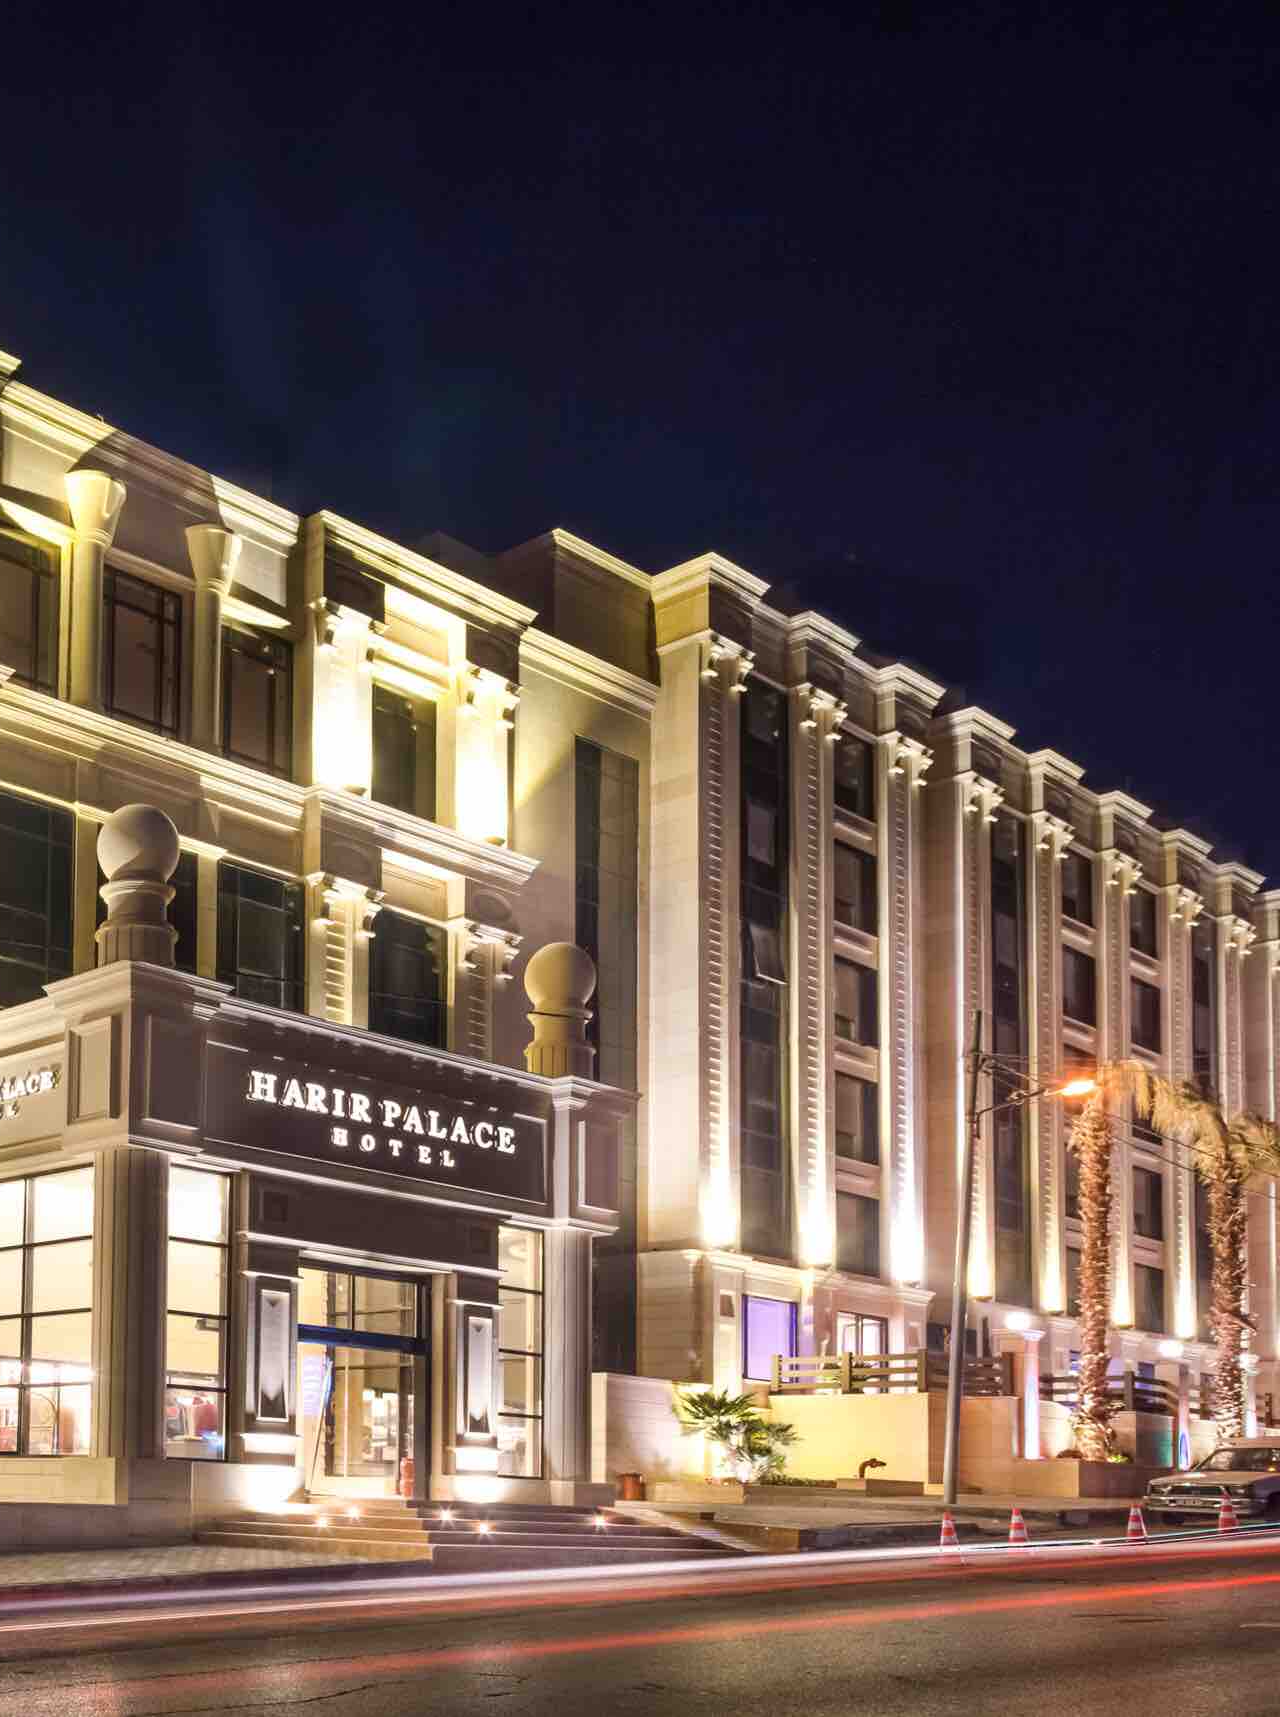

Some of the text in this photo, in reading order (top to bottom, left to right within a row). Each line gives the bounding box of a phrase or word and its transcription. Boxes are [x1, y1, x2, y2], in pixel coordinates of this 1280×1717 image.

[248, 1070, 516, 1154] HARIR PALACE
[331, 1127, 455, 1167] HOTEL
